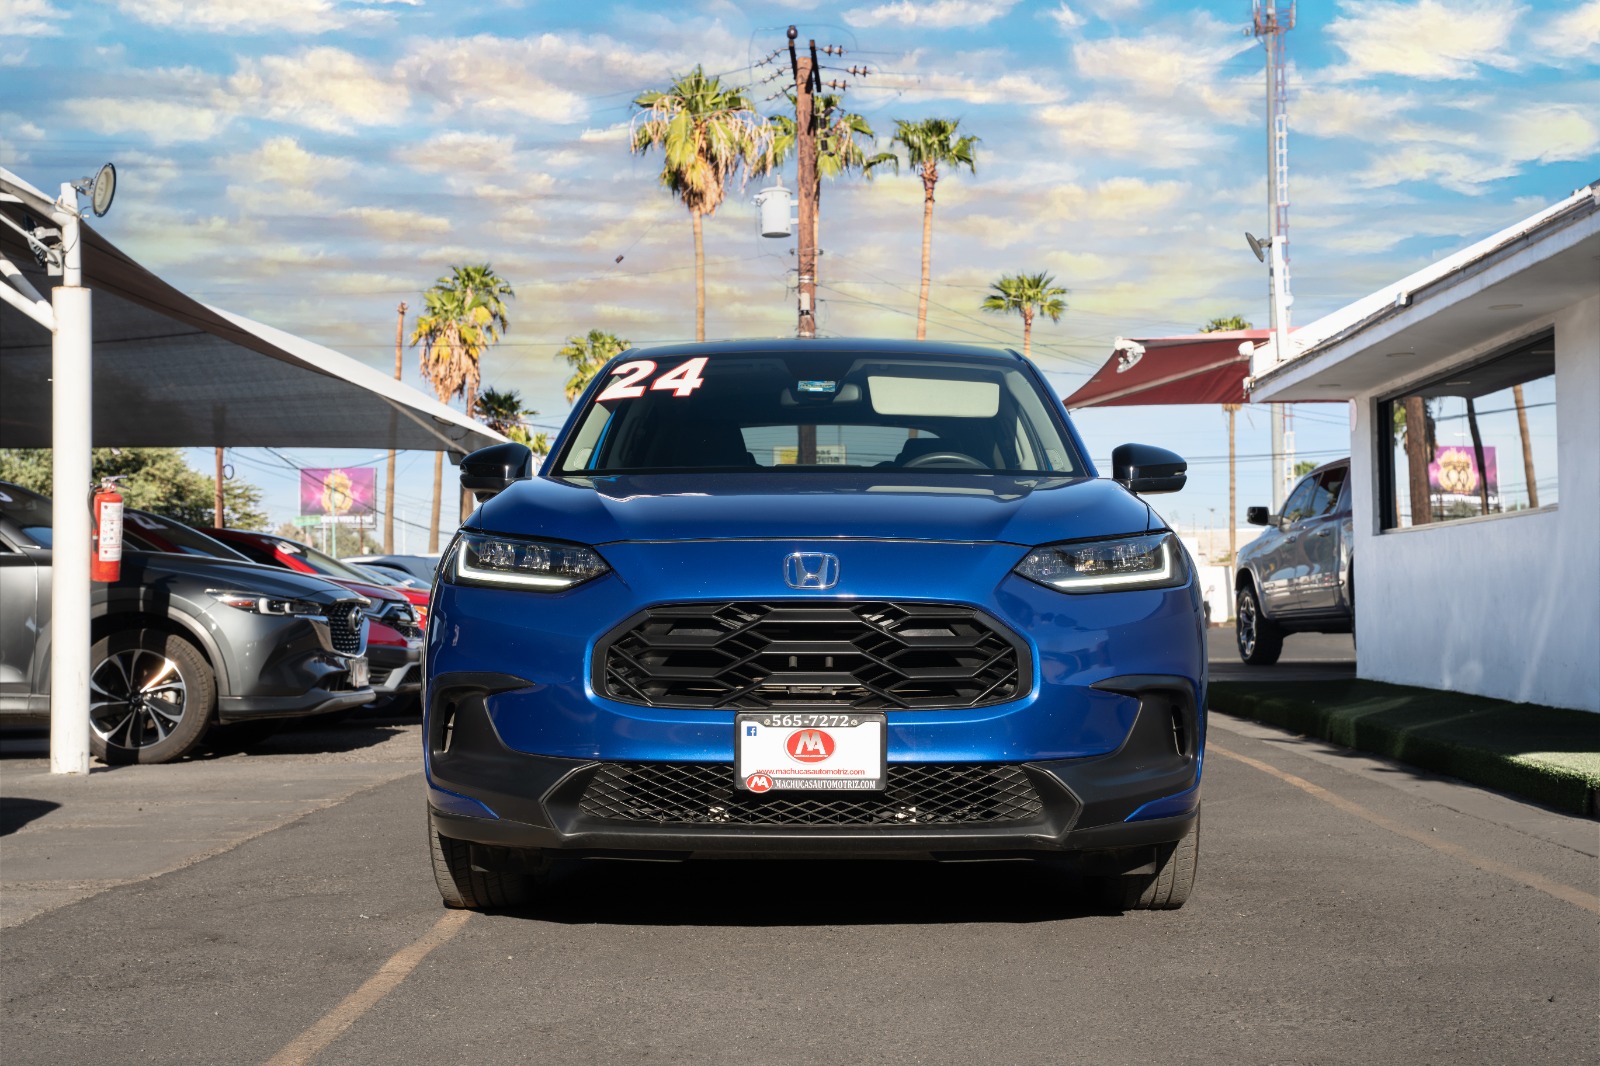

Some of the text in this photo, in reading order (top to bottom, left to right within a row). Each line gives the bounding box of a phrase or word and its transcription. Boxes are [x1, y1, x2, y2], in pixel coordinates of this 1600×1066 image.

[595, 357, 709, 402] 24
[772, 714, 849, 727] 565-7272
[756, 768, 866, 776] www.machucasautomotriz.com
